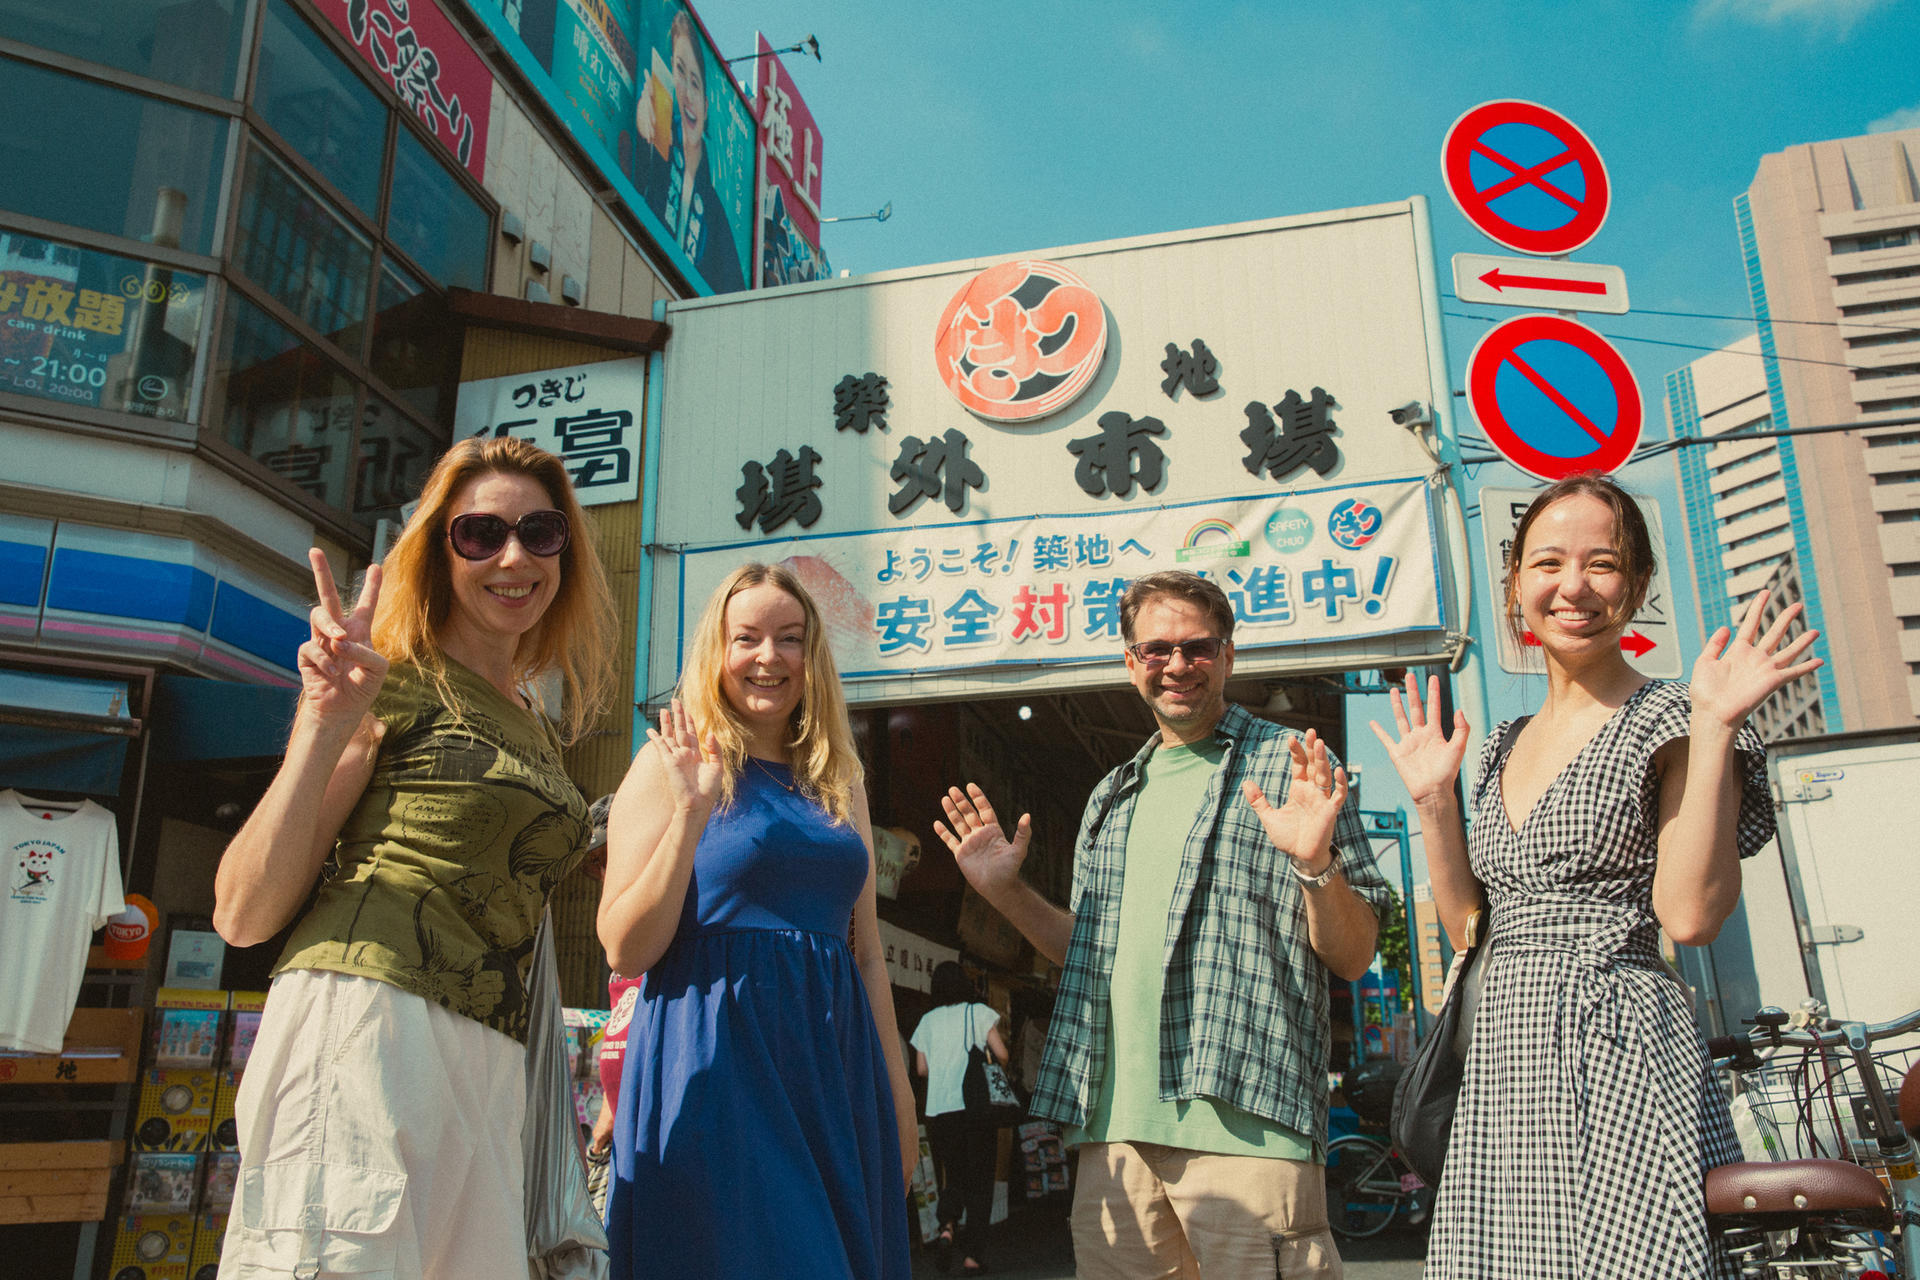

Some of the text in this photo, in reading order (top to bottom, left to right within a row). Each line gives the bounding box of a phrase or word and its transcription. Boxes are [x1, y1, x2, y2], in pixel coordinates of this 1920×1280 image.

[8, 317, 86, 342] can drink
[49, 383, 93, 401] 20:00
[512, 373, 588, 409] つきじ
[1268, 518, 1310, 534] SAFETY
[1275, 536, 1305, 549] CHUO
[875, 555, 1398, 655] 安全対策進中!
[13, 840, 66, 855] TOKYO JAPAN
[111, 925, 142, 937] TOKYO
[56, 1060, 77, 1080] 地
